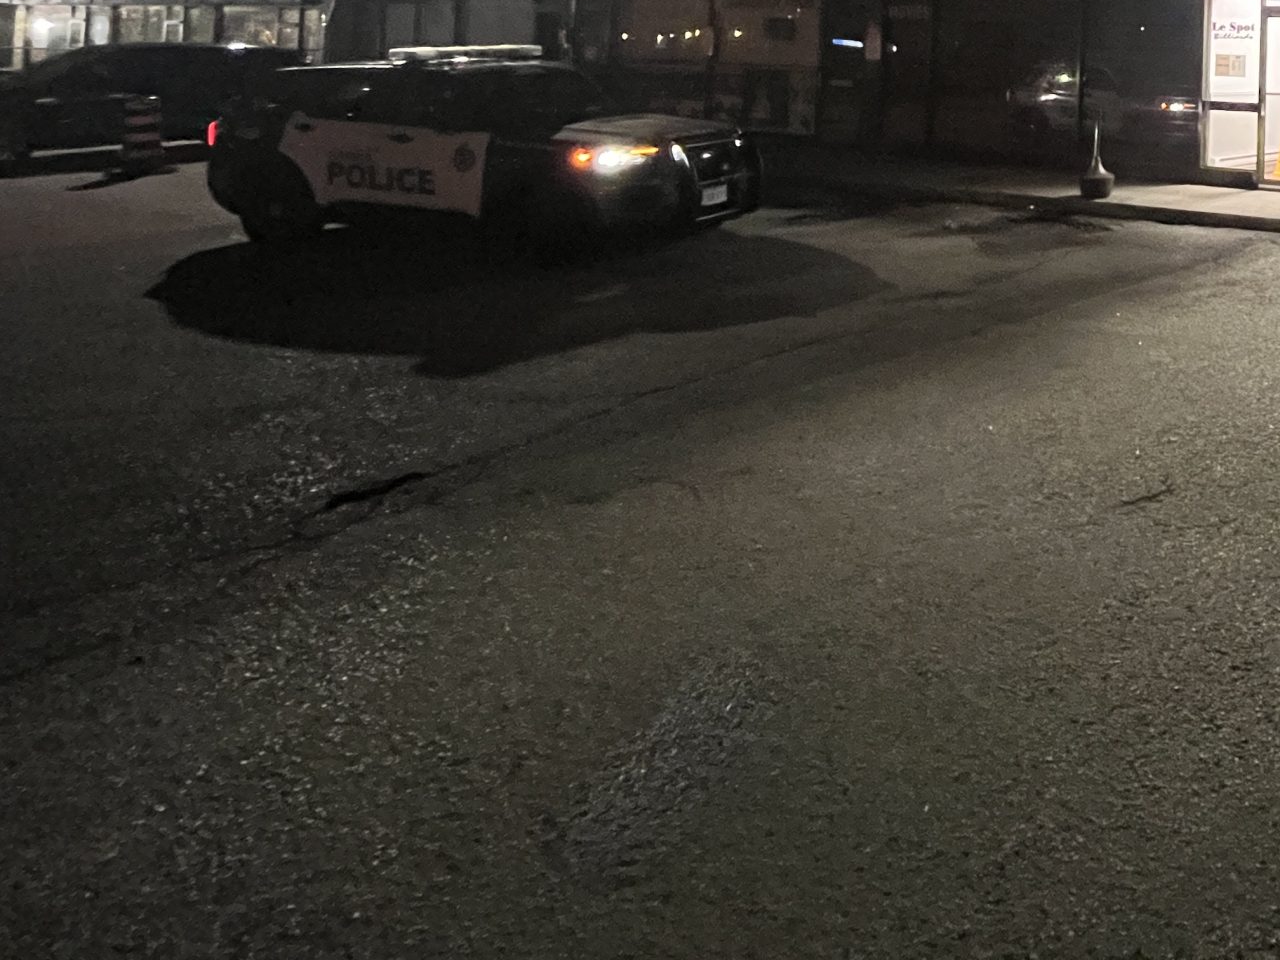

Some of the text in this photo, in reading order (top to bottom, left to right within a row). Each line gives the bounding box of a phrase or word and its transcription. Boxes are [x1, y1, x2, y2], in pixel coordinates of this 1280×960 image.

[1212, 21, 1255, 33] Le Spot
[327, 162, 436, 195] POLICE
